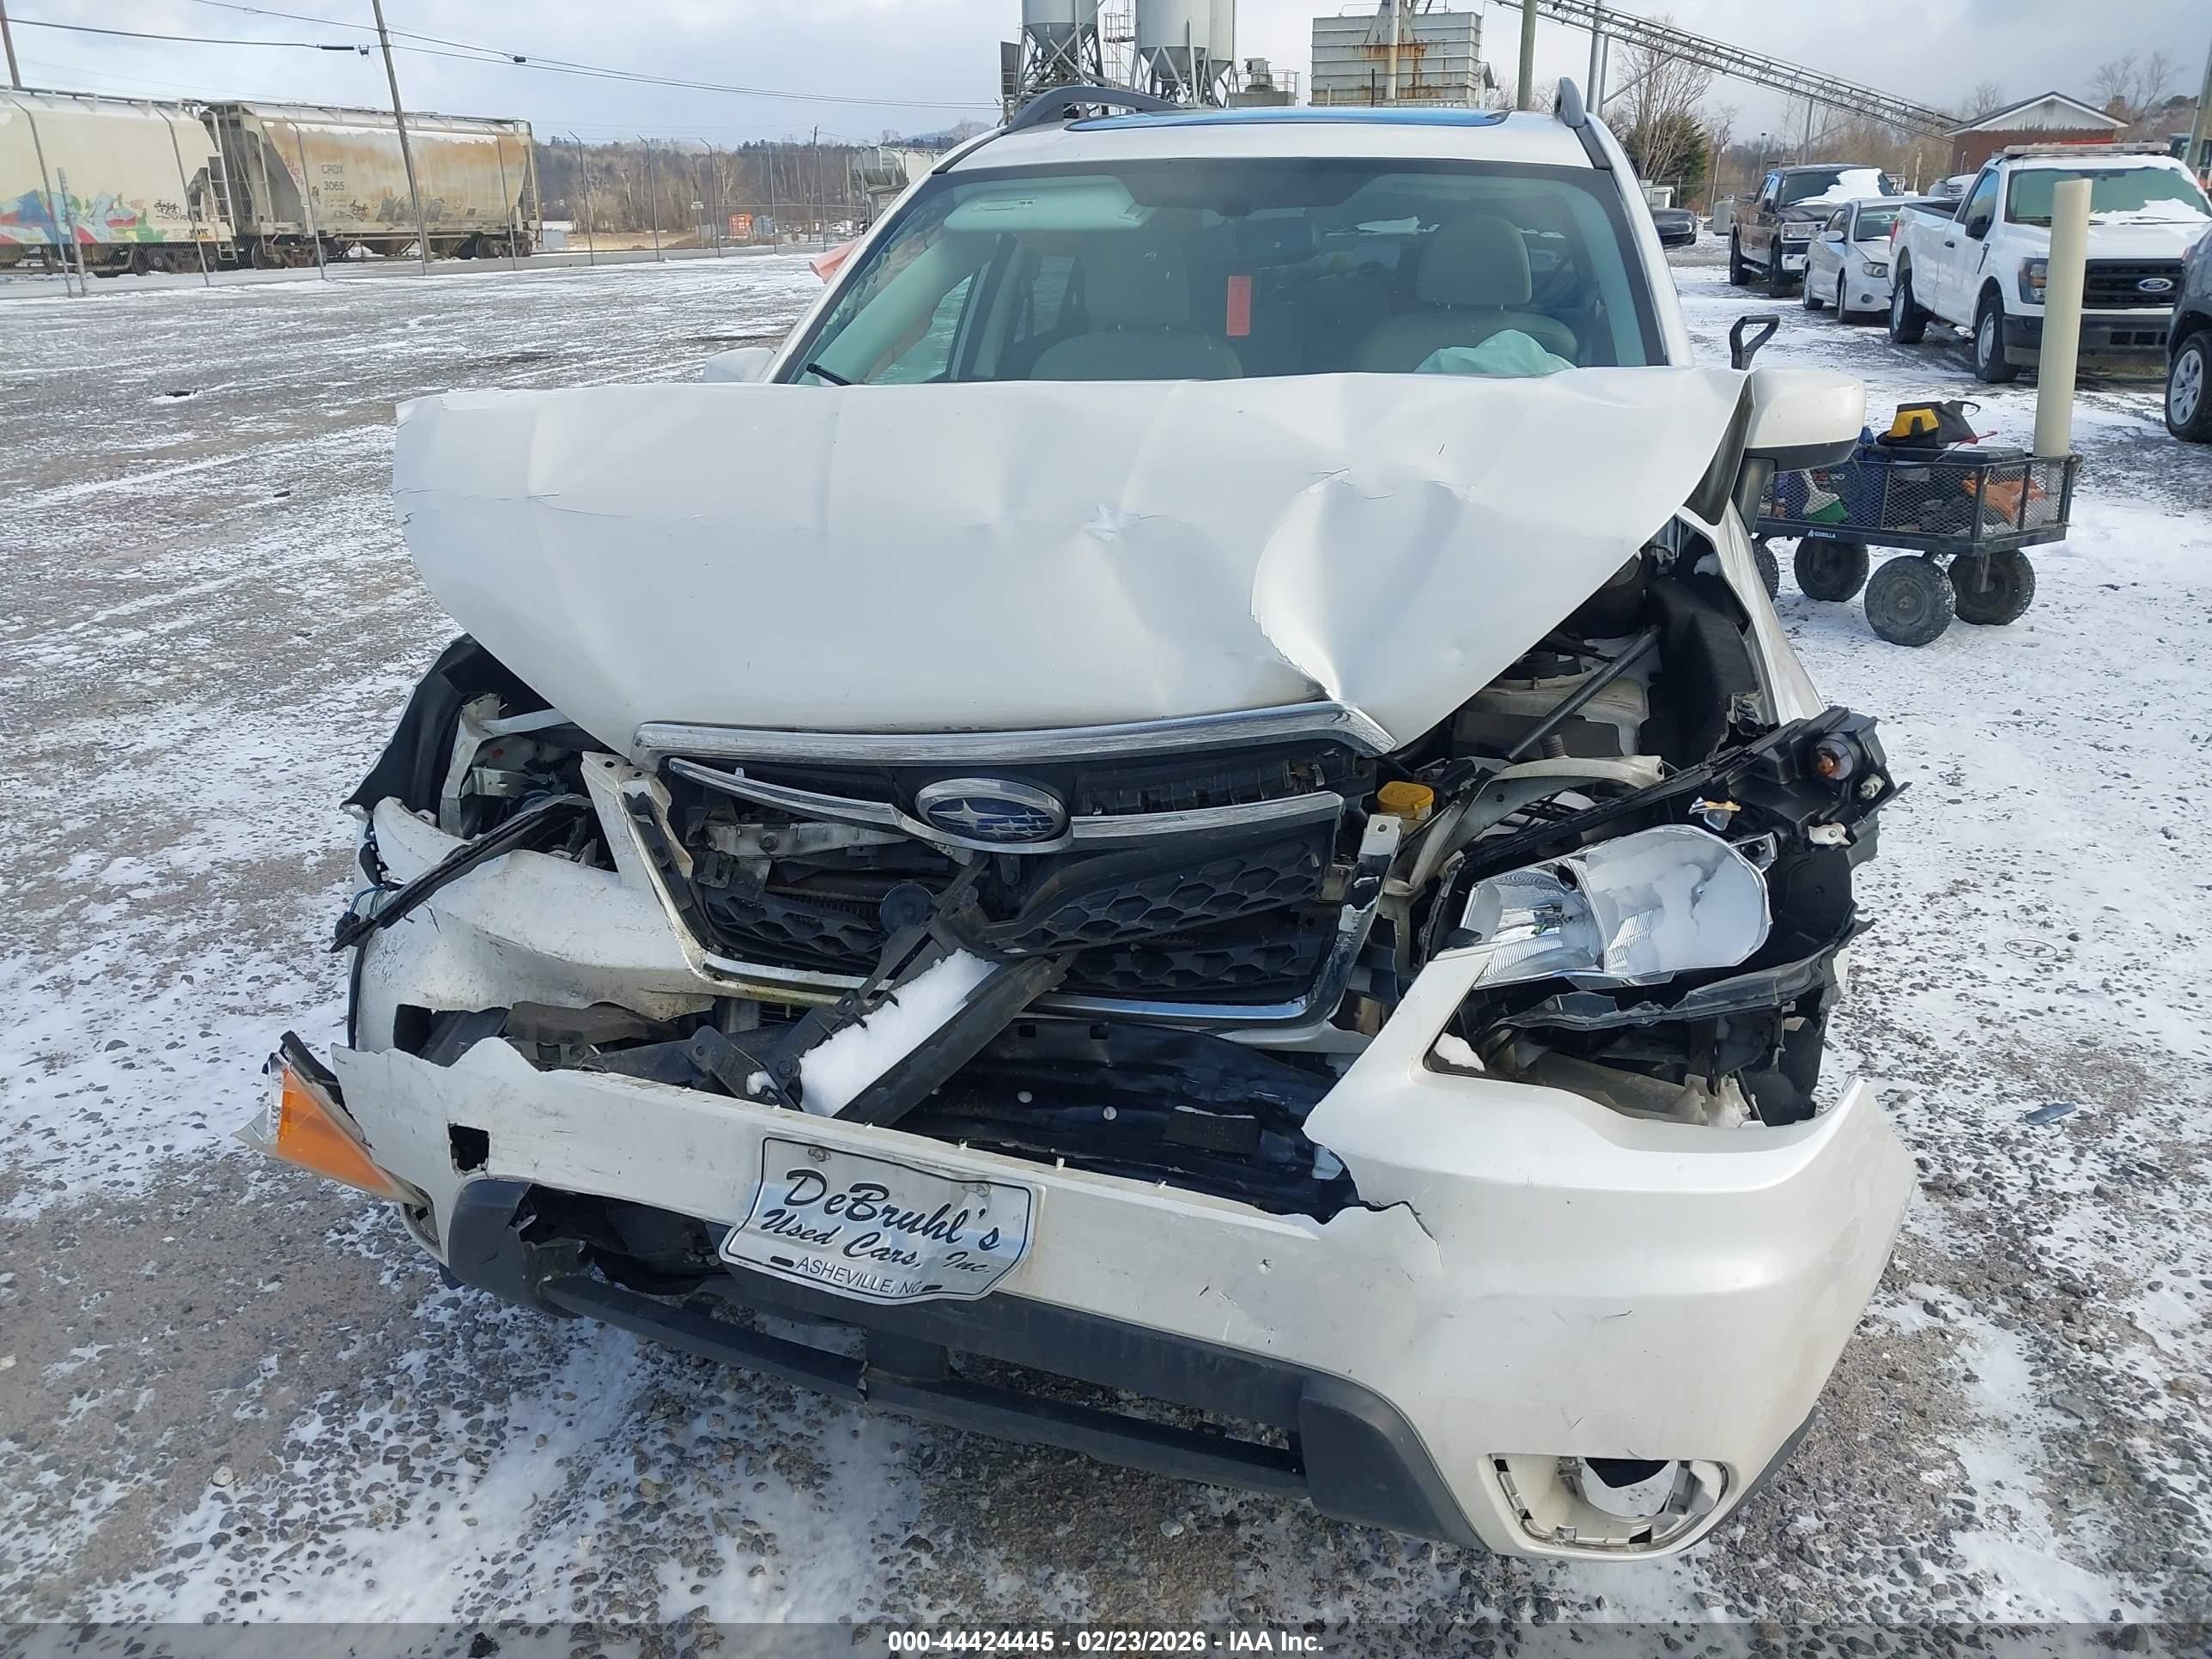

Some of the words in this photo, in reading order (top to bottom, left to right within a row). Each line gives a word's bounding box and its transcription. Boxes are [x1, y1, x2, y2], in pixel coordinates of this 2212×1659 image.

[323, 180, 344, 191] 3065
[786, 1169, 1000, 1251] DeBruhl's
[760, 1208, 842, 1245] Used
[843, 1231, 921, 1269] Cars,
[943, 1251, 992, 1274] Inc.
[796, 1256, 895, 1294] ASHEVILLE,
[901, 1279, 923, 1294] NC
